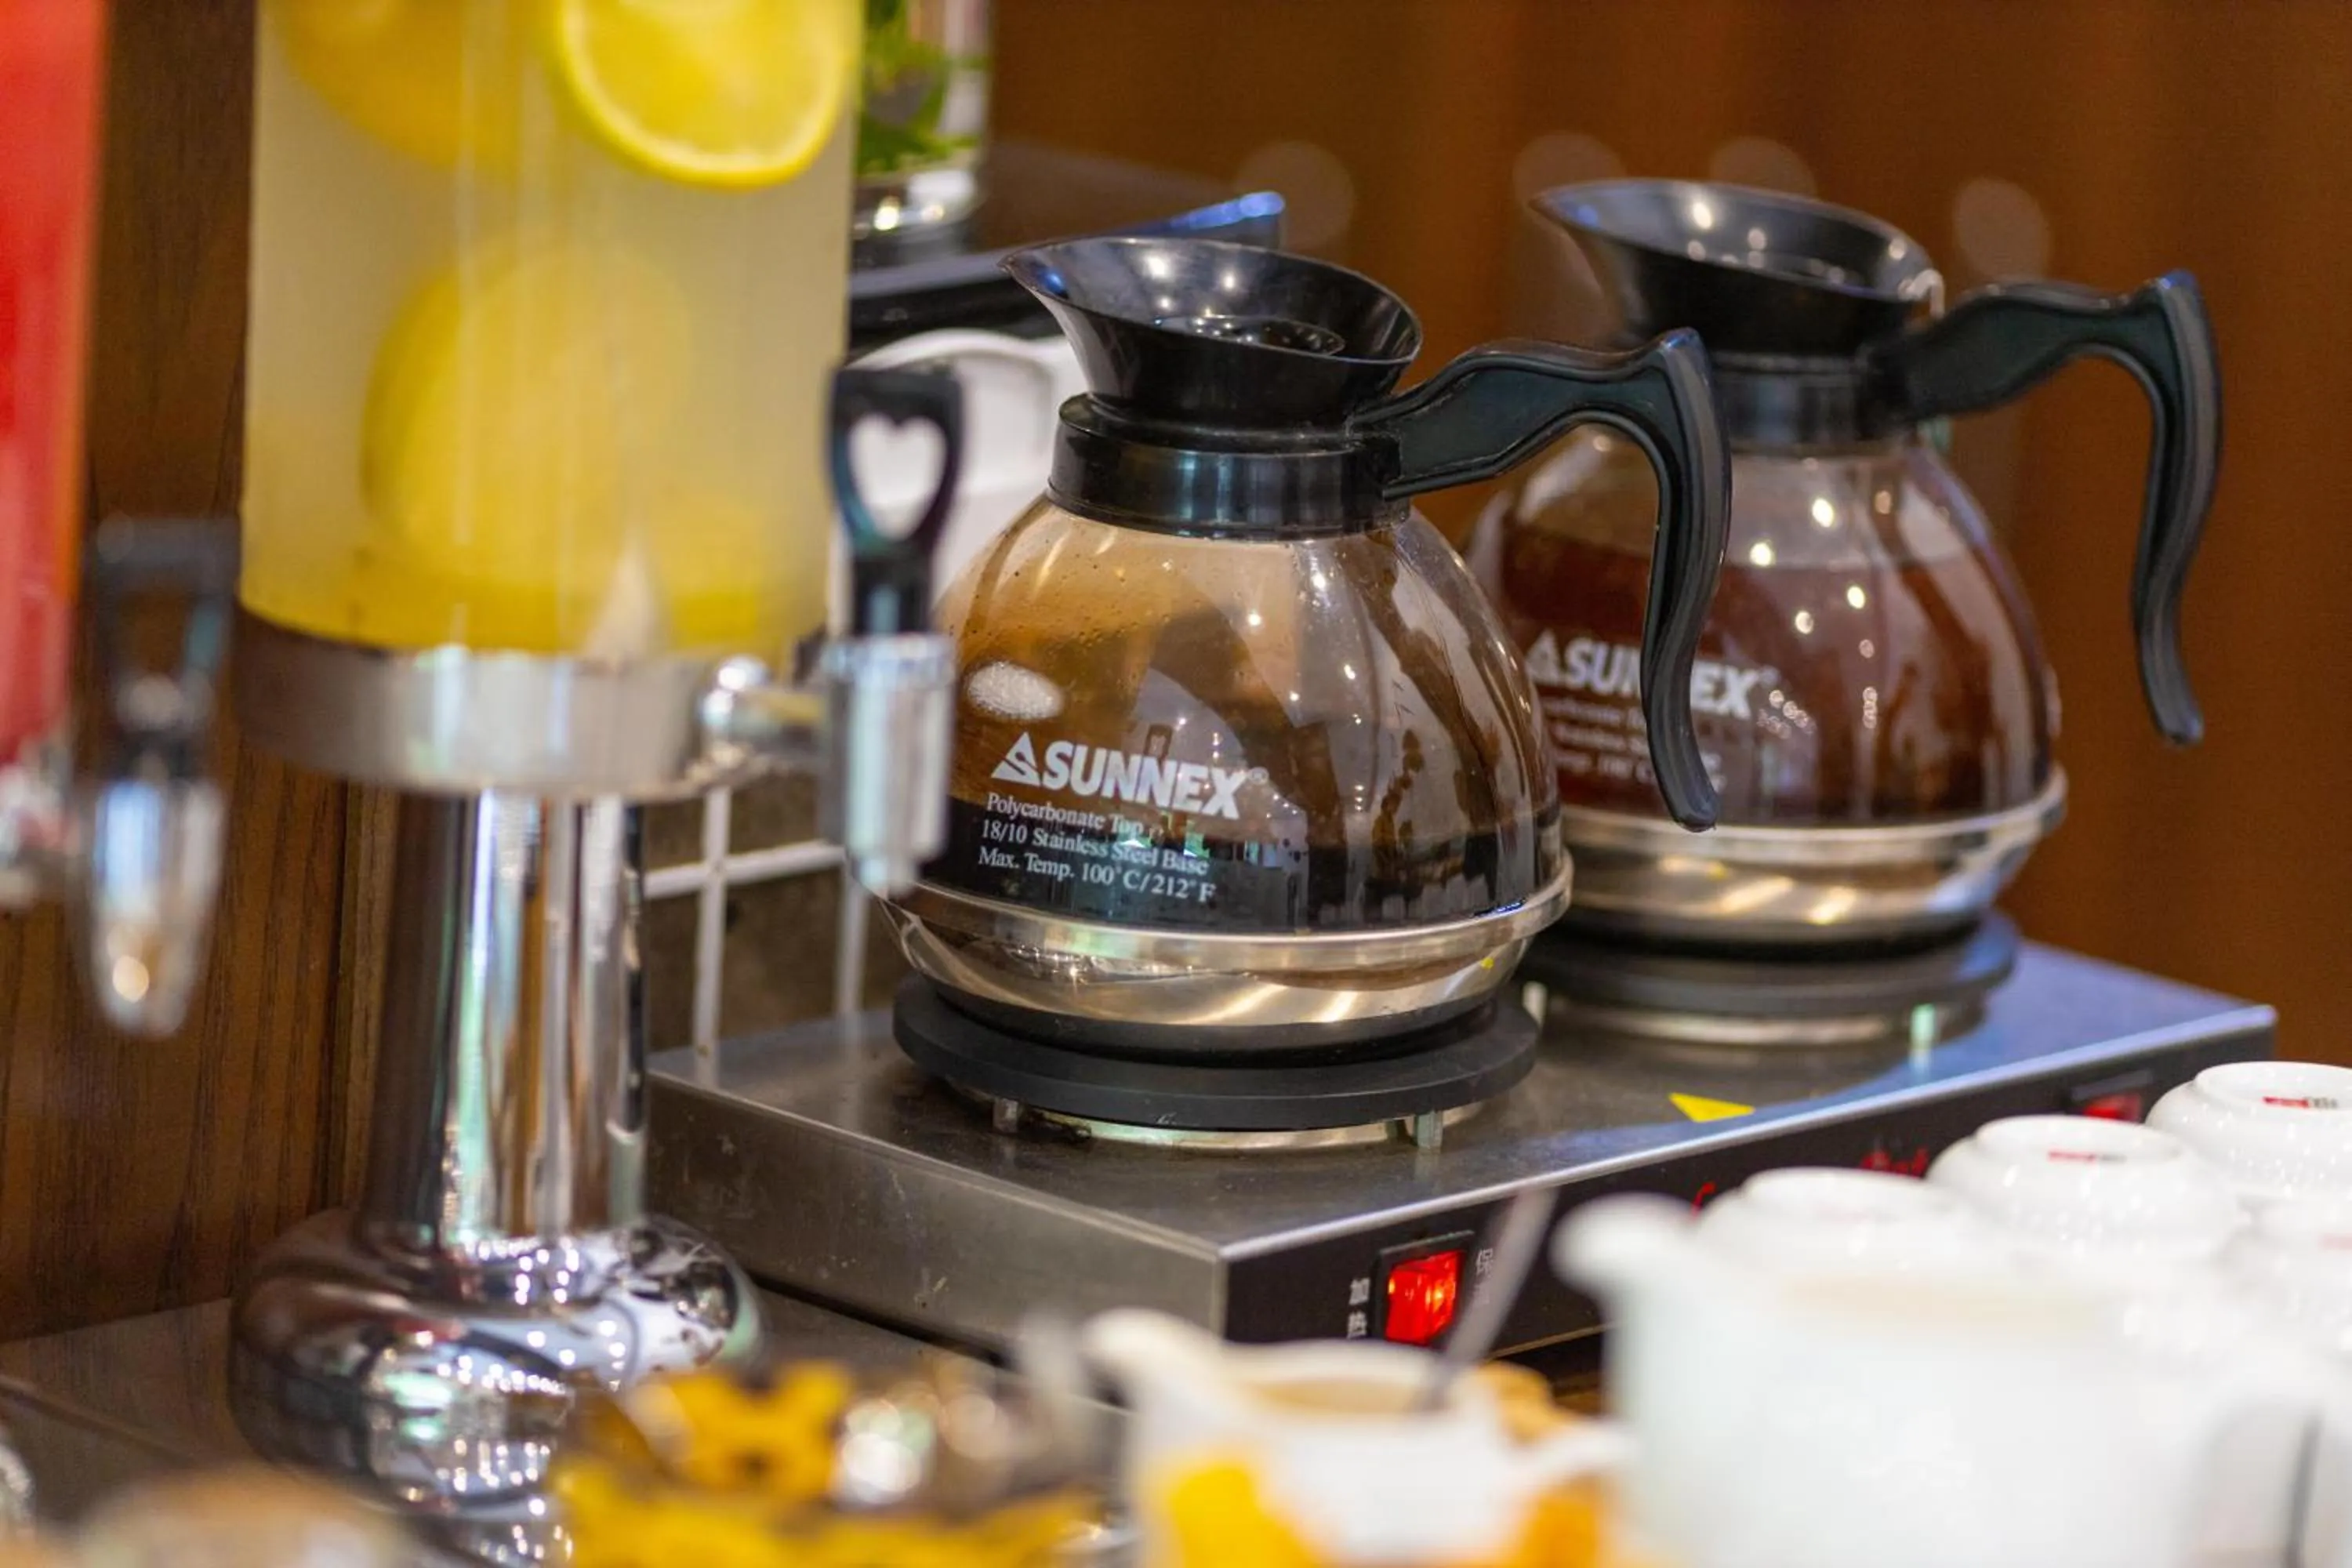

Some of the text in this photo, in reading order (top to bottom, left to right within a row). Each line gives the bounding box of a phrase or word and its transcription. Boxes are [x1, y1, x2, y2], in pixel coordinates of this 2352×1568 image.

[1043, 740, 1247, 820] SUNNEX
[986, 791, 1144, 837] Polycarbonate Top
[978, 845, 1019, 869] Max.
[1024, 852, 1075, 882] Temp.
[982, 818, 1210, 876] 18/10 Stainless Steel Base
